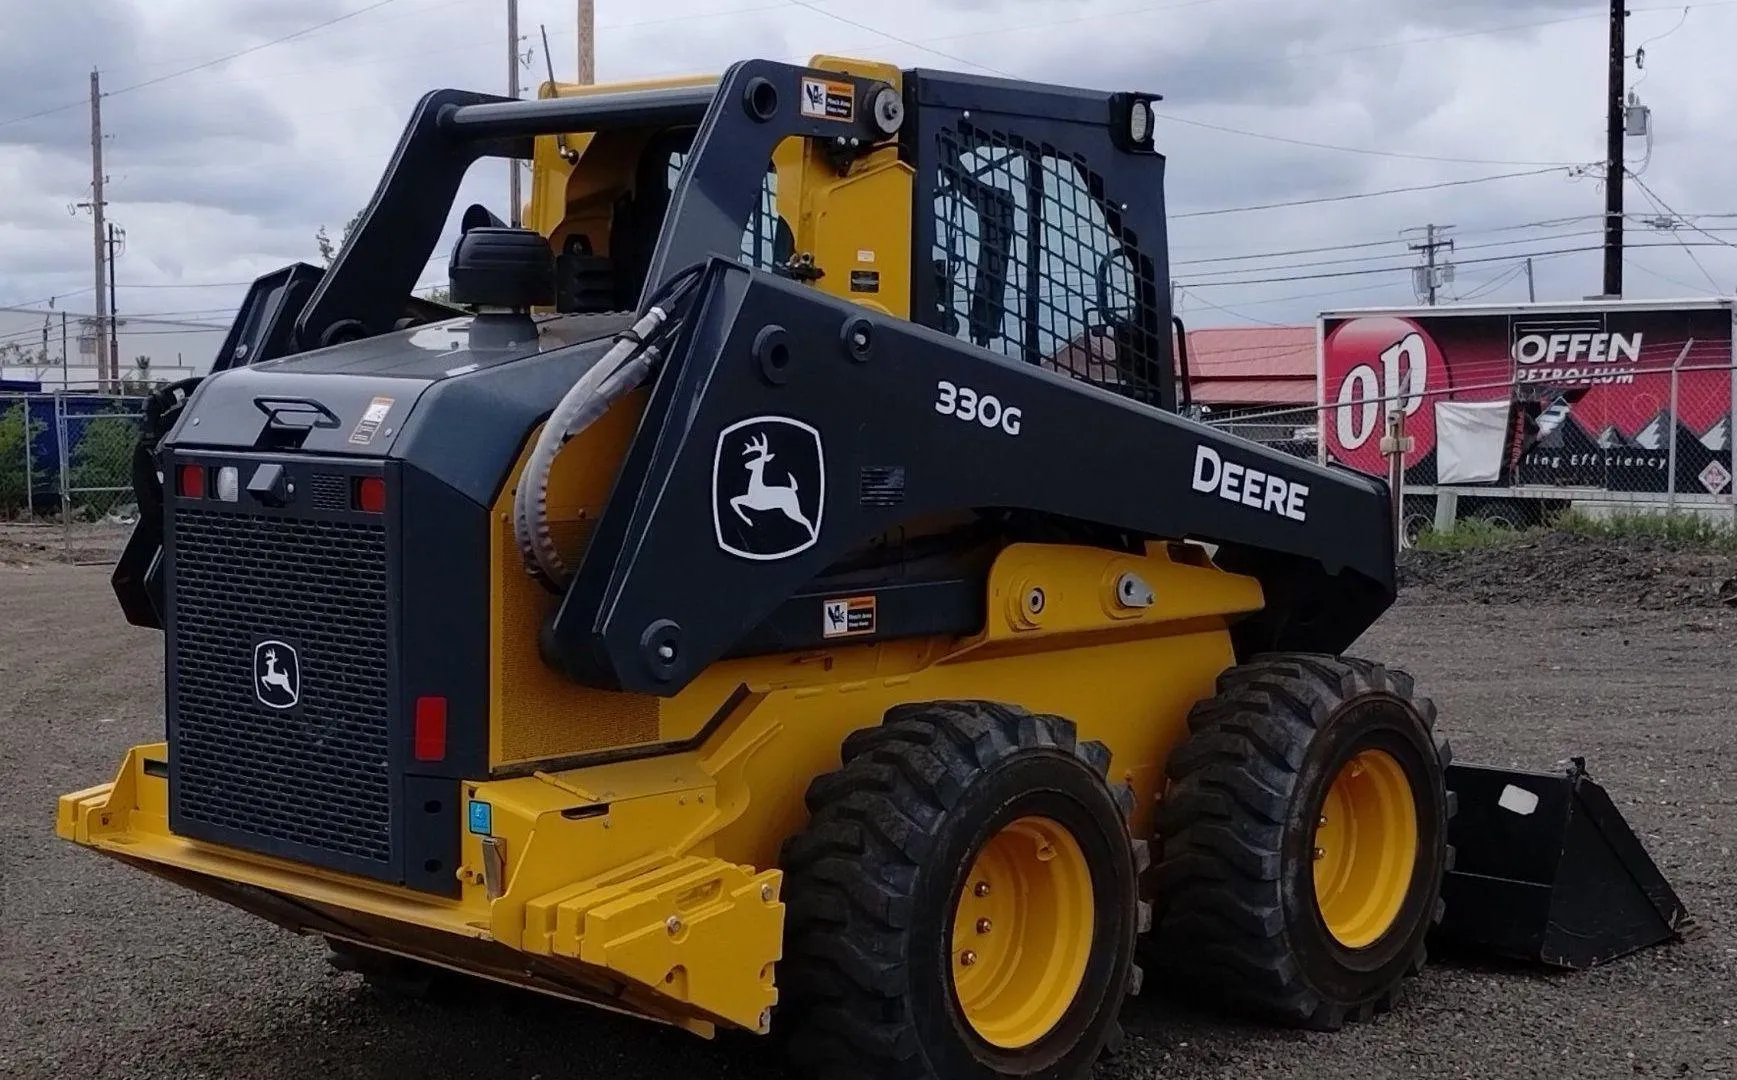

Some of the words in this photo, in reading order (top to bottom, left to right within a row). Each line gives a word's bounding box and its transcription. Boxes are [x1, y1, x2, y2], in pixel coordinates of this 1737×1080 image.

[1511, 332, 1643, 364] OFFEN
[1517, 367, 1635, 384] PETROLEUM
[934, 381, 1022, 436] 330G
[1570, 452, 1667, 471] Effciency
[1192, 445, 1309, 522] DEERE
